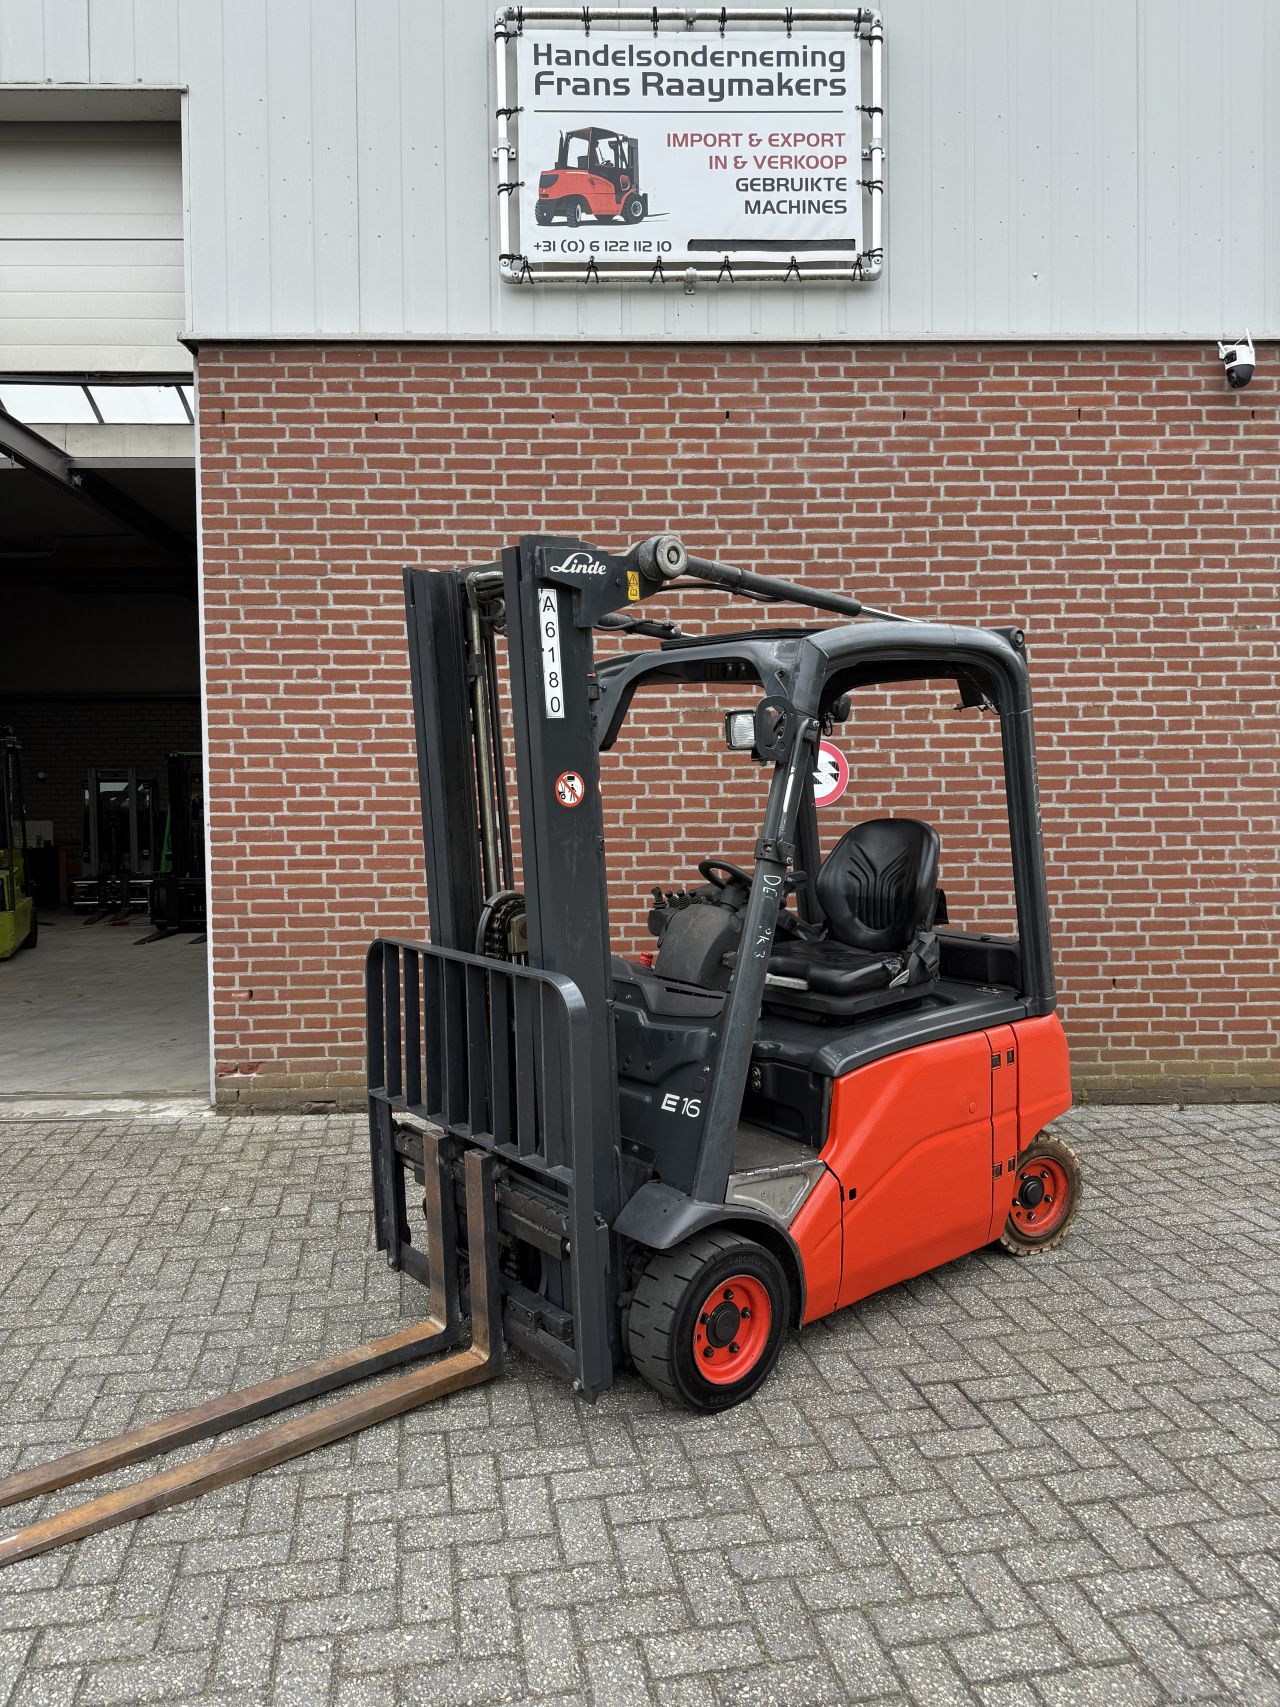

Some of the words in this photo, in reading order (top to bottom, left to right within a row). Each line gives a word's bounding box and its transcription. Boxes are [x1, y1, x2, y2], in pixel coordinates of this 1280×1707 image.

[533, 43, 846, 72] Handelsonderneming
[534, 70, 631, 96] Frans
[641, 71, 847, 103] Raaymakers
[666, 132, 744, 148] IMPORT
[749, 133, 763, 147] &
[768, 132, 846, 148] EXPORT
[708, 155, 728, 170] IN
[734, 155, 747, 170] &
[753, 154, 848, 170] VERKOOP
[735, 177, 848, 193] GEBRUIKTE
[744, 199, 848, 215] MACHINES
[533, 240, 556, 252] +31
[560, 239, 585, 254] (0)
[589, 240, 600, 252] 6
[604, 240, 630, 252] 122
[550, 552, 607, 575] Linde
